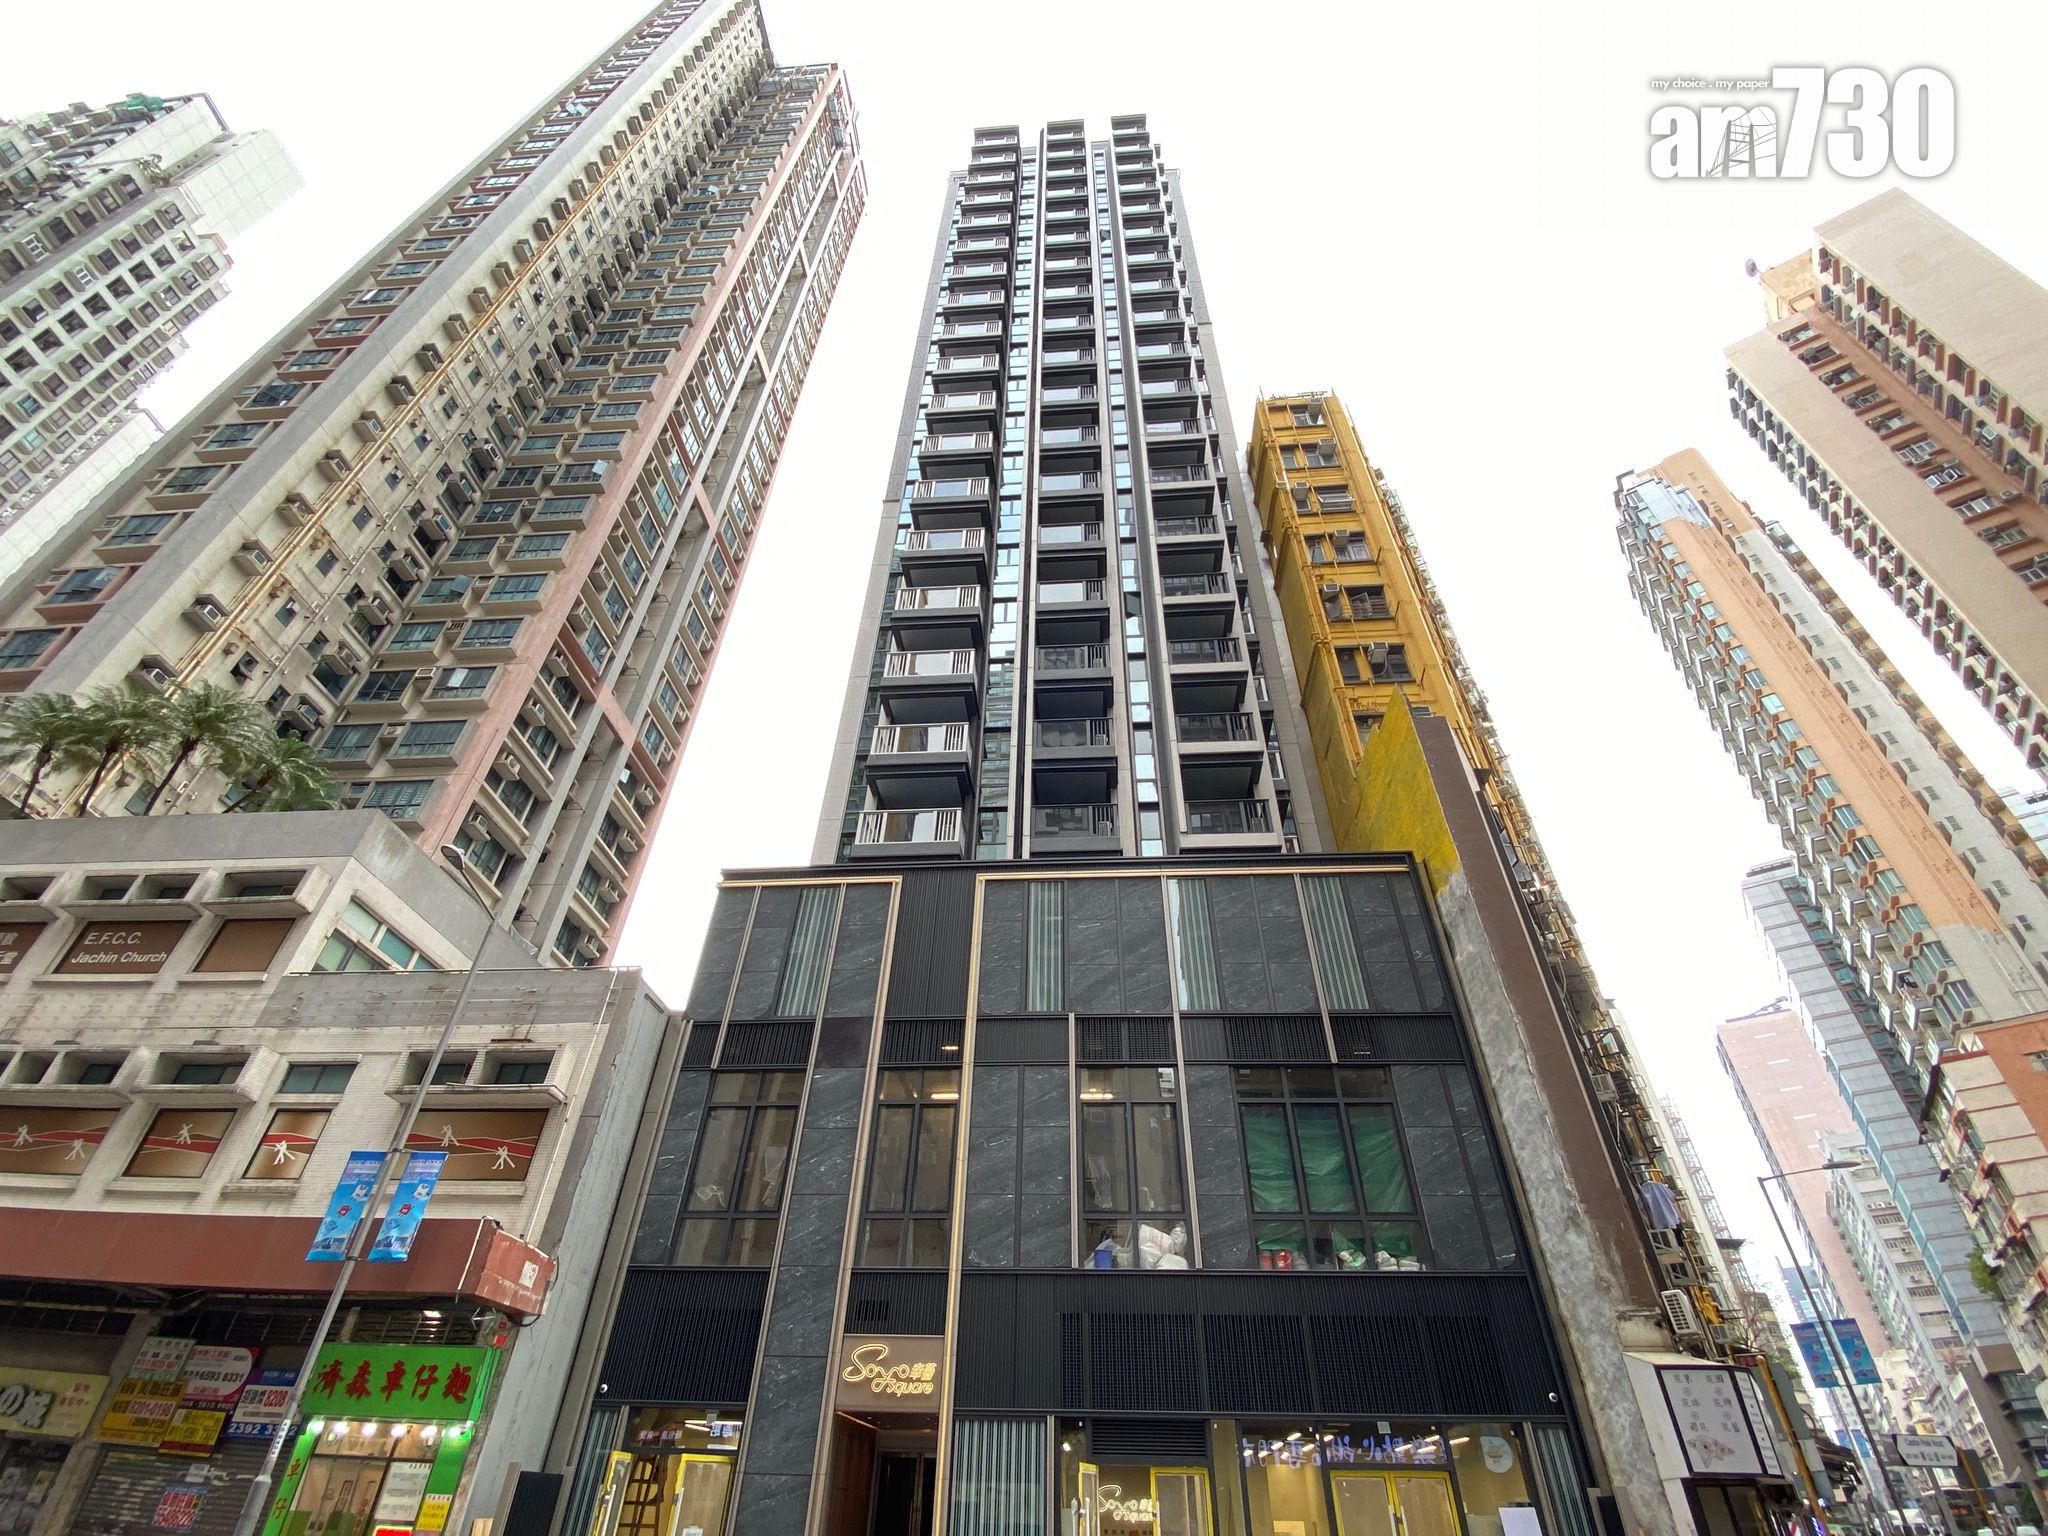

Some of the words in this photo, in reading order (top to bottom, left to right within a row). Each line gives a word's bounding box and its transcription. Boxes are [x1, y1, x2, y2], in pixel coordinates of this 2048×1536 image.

[84, 932, 141, 945] E.F.C.C.
[71, 952, 118, 963] Jachin
[121, 952, 167, 963] Church
[228, 1423, 261, 1434] 2392
[265, 1424, 298, 1435] 332
